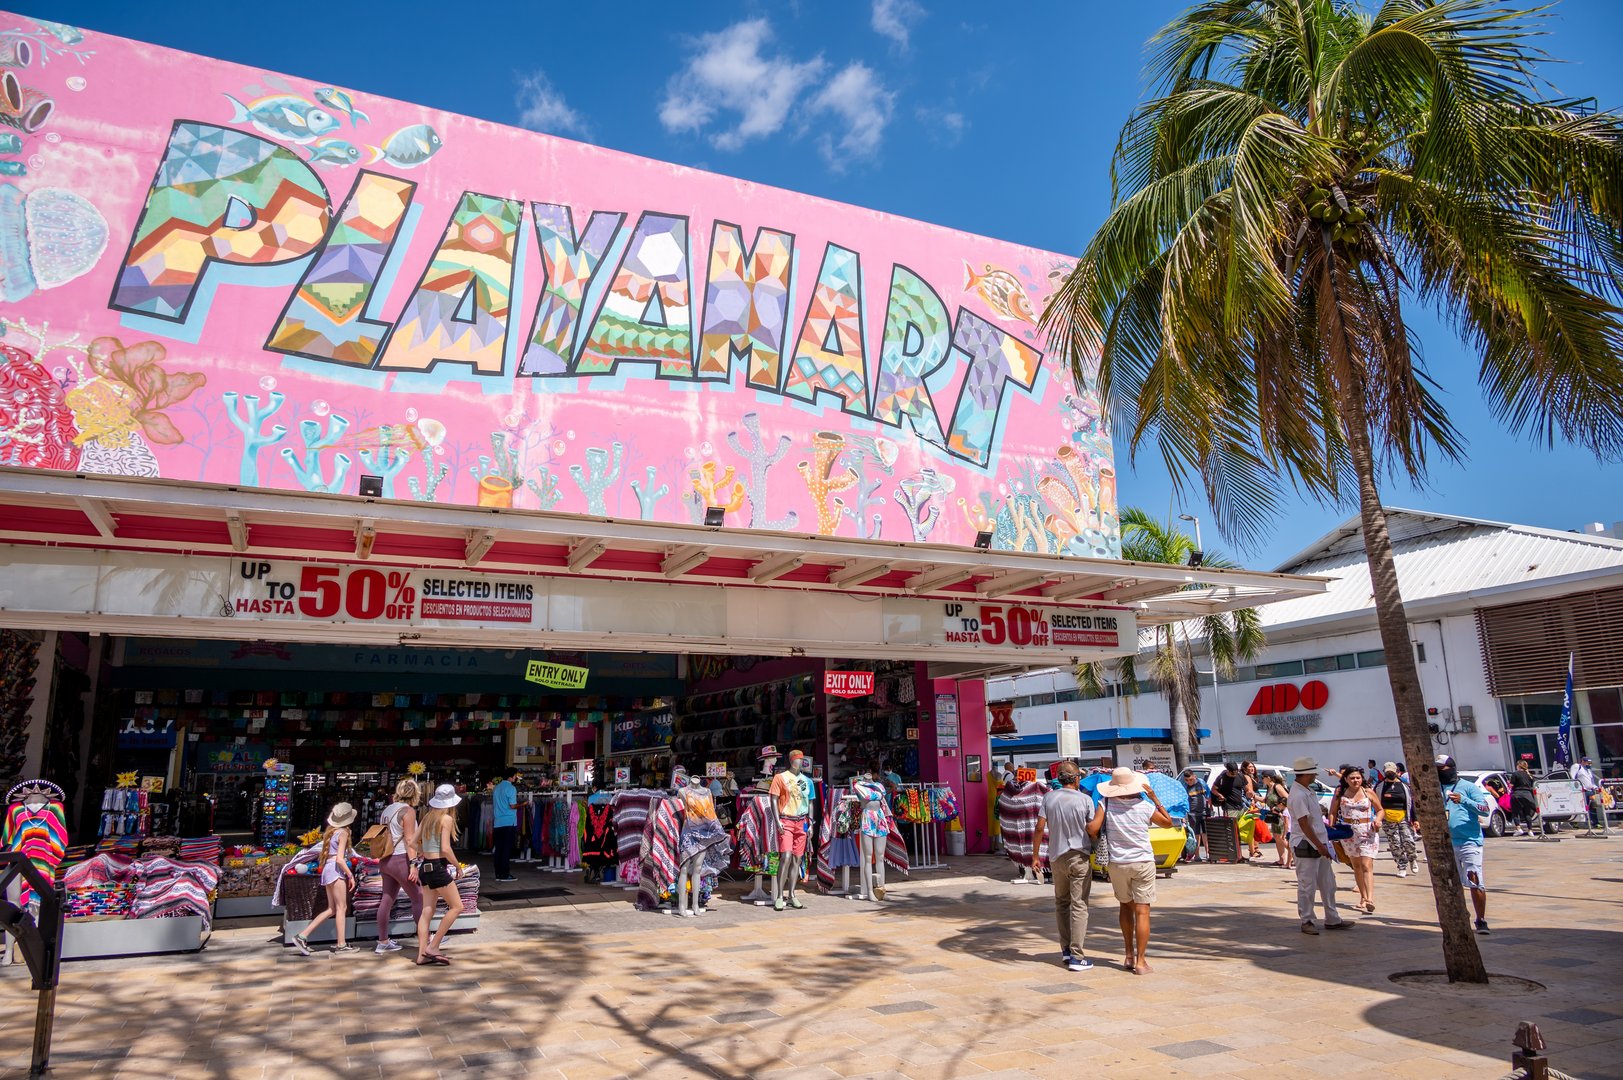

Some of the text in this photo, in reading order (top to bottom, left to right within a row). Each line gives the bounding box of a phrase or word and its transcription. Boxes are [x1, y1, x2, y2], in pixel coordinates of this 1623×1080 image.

[108, 119, 1043, 469] PLAYAMART
[241, 562, 271, 579] UP
[266, 582, 295, 600] TO
[299, 566, 415, 620] 50%
[423, 579, 533, 600] SELECTED ITEMS
[236, 599, 295, 614] HASTA
[386, 604, 414, 620] OFF
[423, 602, 531, 618] DESCUENTOS EN PRODUCTOS SELECCIONADOS
[945, 603, 963, 617] UP
[961, 618, 979, 631] TO
[980, 606, 1048, 646] 50%
[1052, 614, 1118, 630] SELECTED ITEMS
[946, 631, 980, 643] HASTA
[1032, 635, 1049, 646] OFF
[354, 652, 478, 667] FARMACIA
[529, 664, 560, 679] ENTRY
[561, 668, 586, 684] ONLY
[826, 673, 872, 689] EXIT ONLY
[1246, 680, 1329, 715] ADO
[614, 719, 642, 733] KIDS
[208, 750, 263, 763] SMALL
[325, 747, 394, 757] CASHIER
